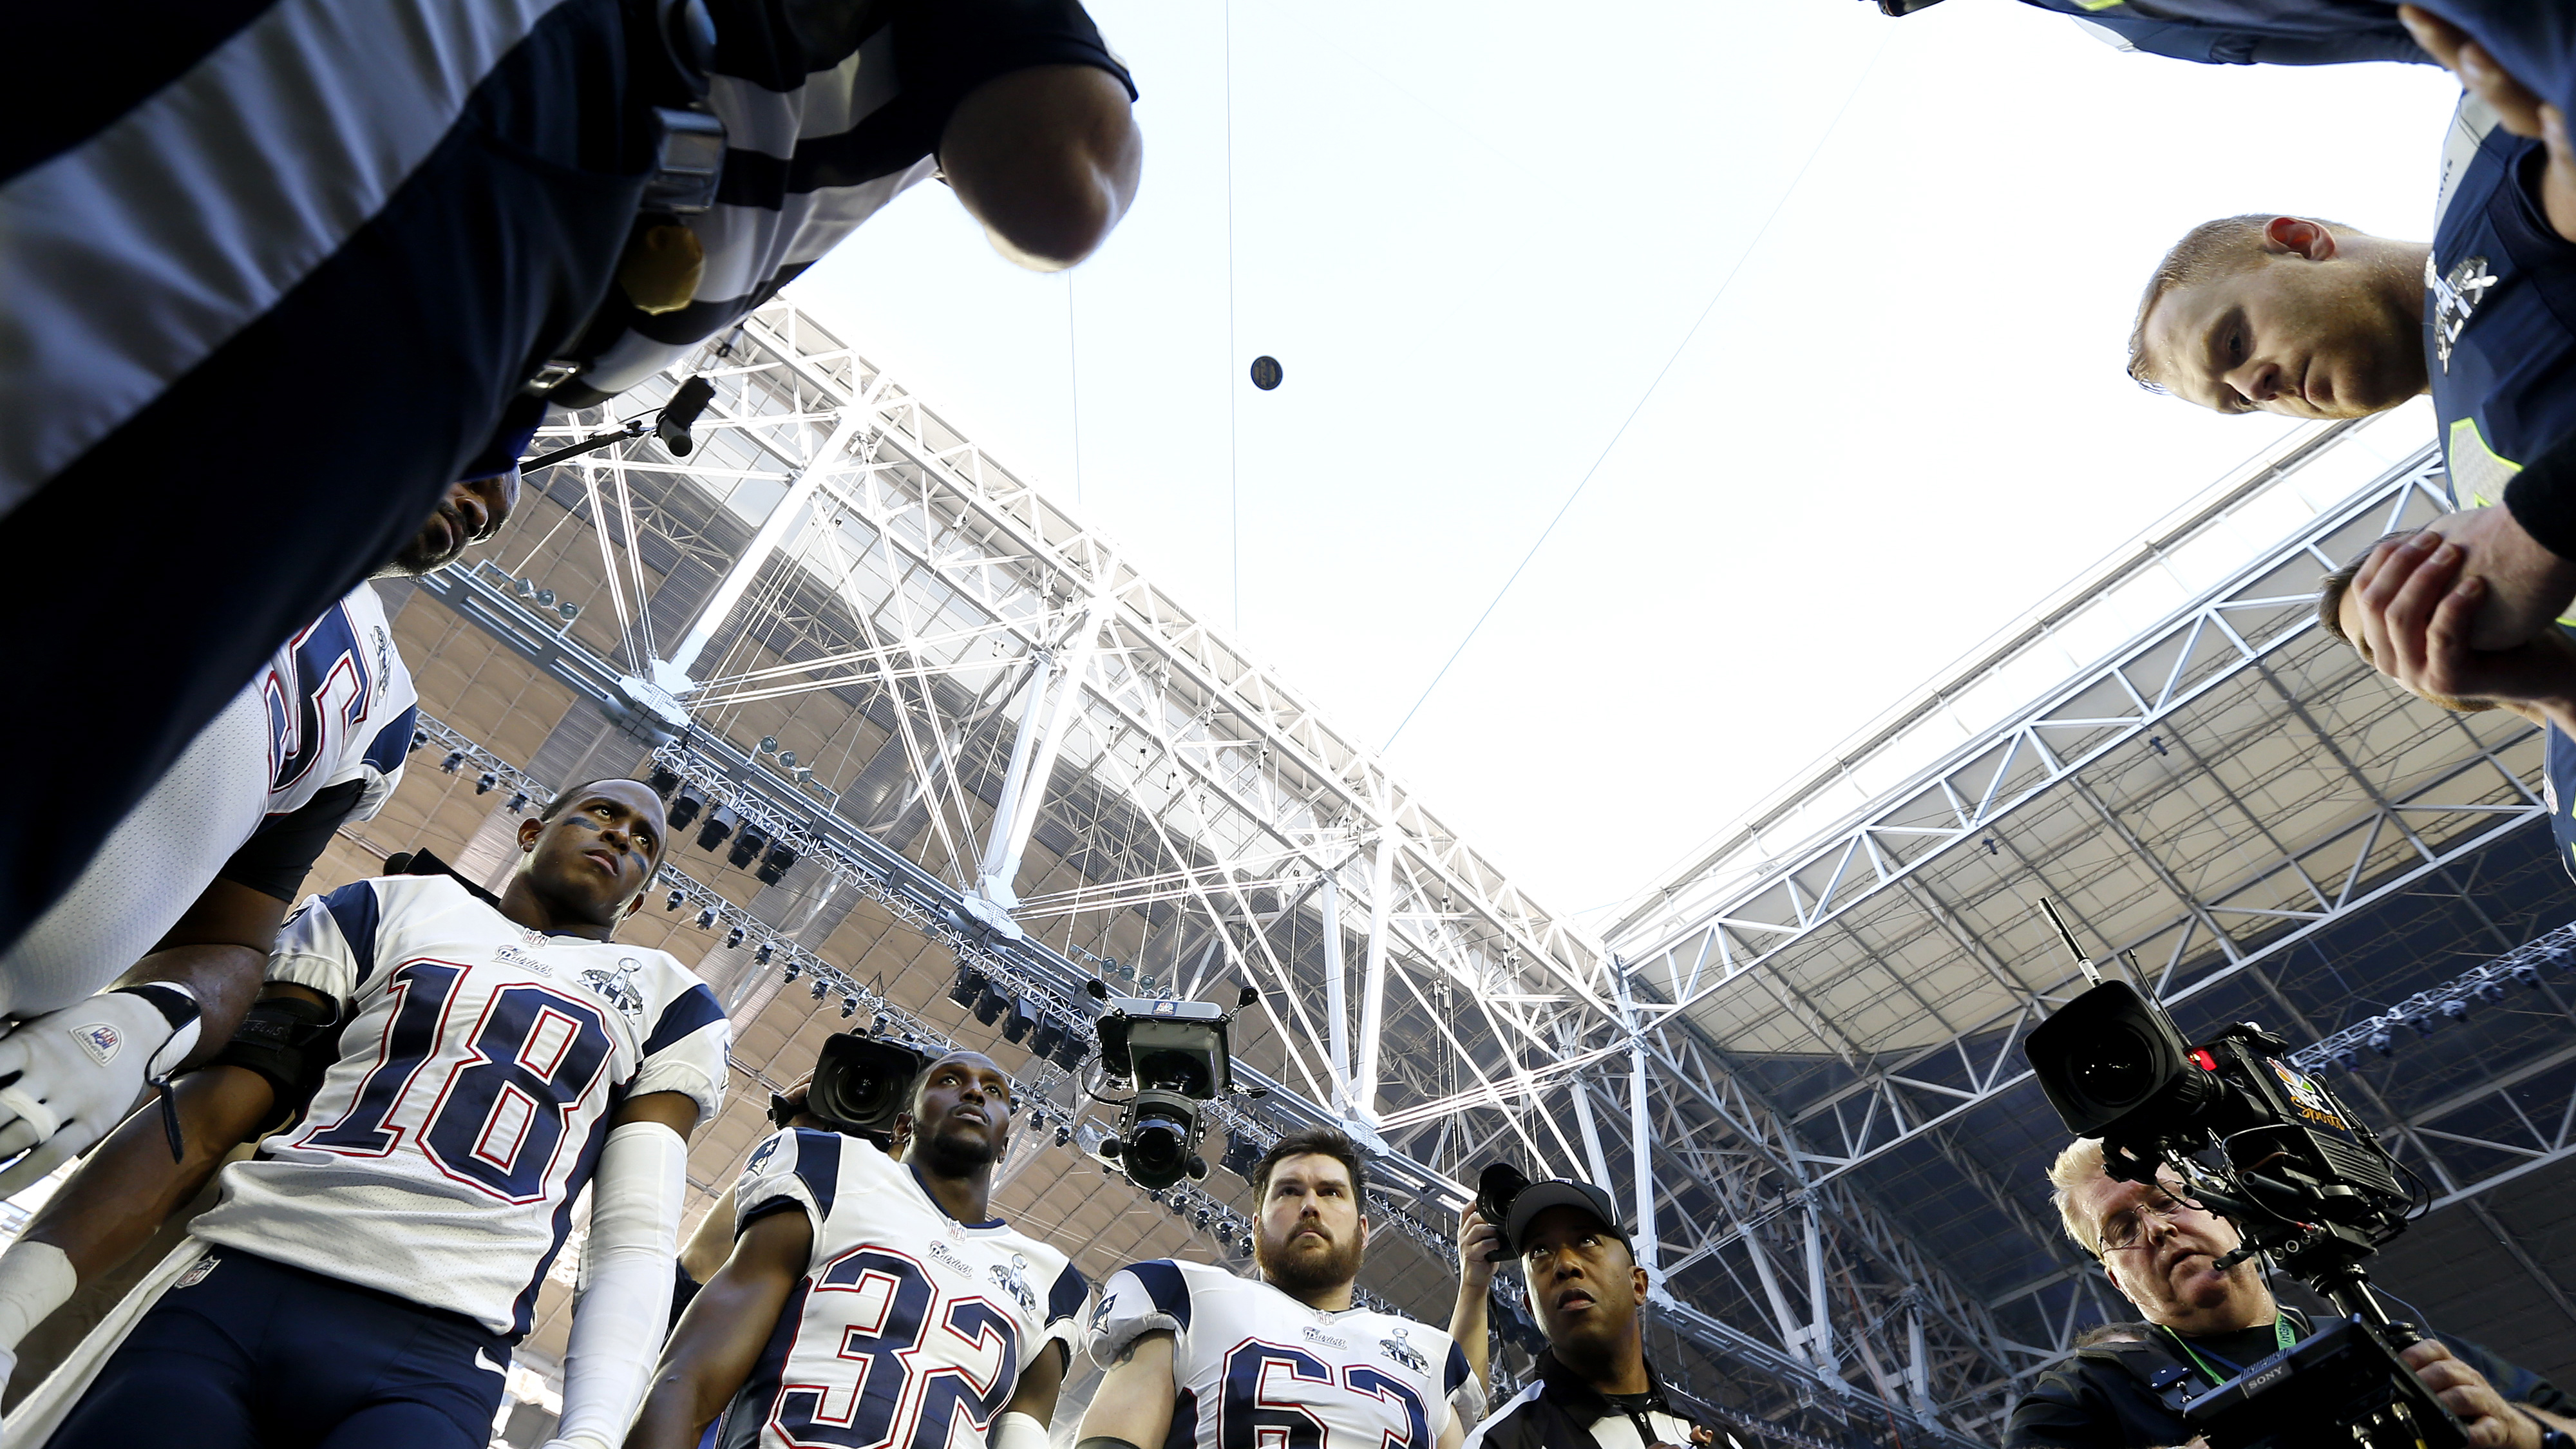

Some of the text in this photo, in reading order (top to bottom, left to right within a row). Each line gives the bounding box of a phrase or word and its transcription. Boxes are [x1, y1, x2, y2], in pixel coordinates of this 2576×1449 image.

[526, 934, 544, 946] NFL
[495, 950, 553, 977] Patriots
[577, 971, 643, 1025] XLIX
[293, 957, 616, 1205] 18
[2284, 1083, 2333, 1115] NBC
[2290, 1096, 2345, 1131] Sports
[949, 1228, 965, 1240] NFL
[928, 1246, 973, 1277] Patriots
[987, 1267, 1036, 1321] XLIX
[1319, 1314, 1334, 1325] NFL
[772, 1244, 1020, 1449] 32
[1305, 1329, 1348, 1350] Patriots
[1379, 1341, 1431, 1378] XLIX
[2248, 1366, 2282, 1389] SONY
